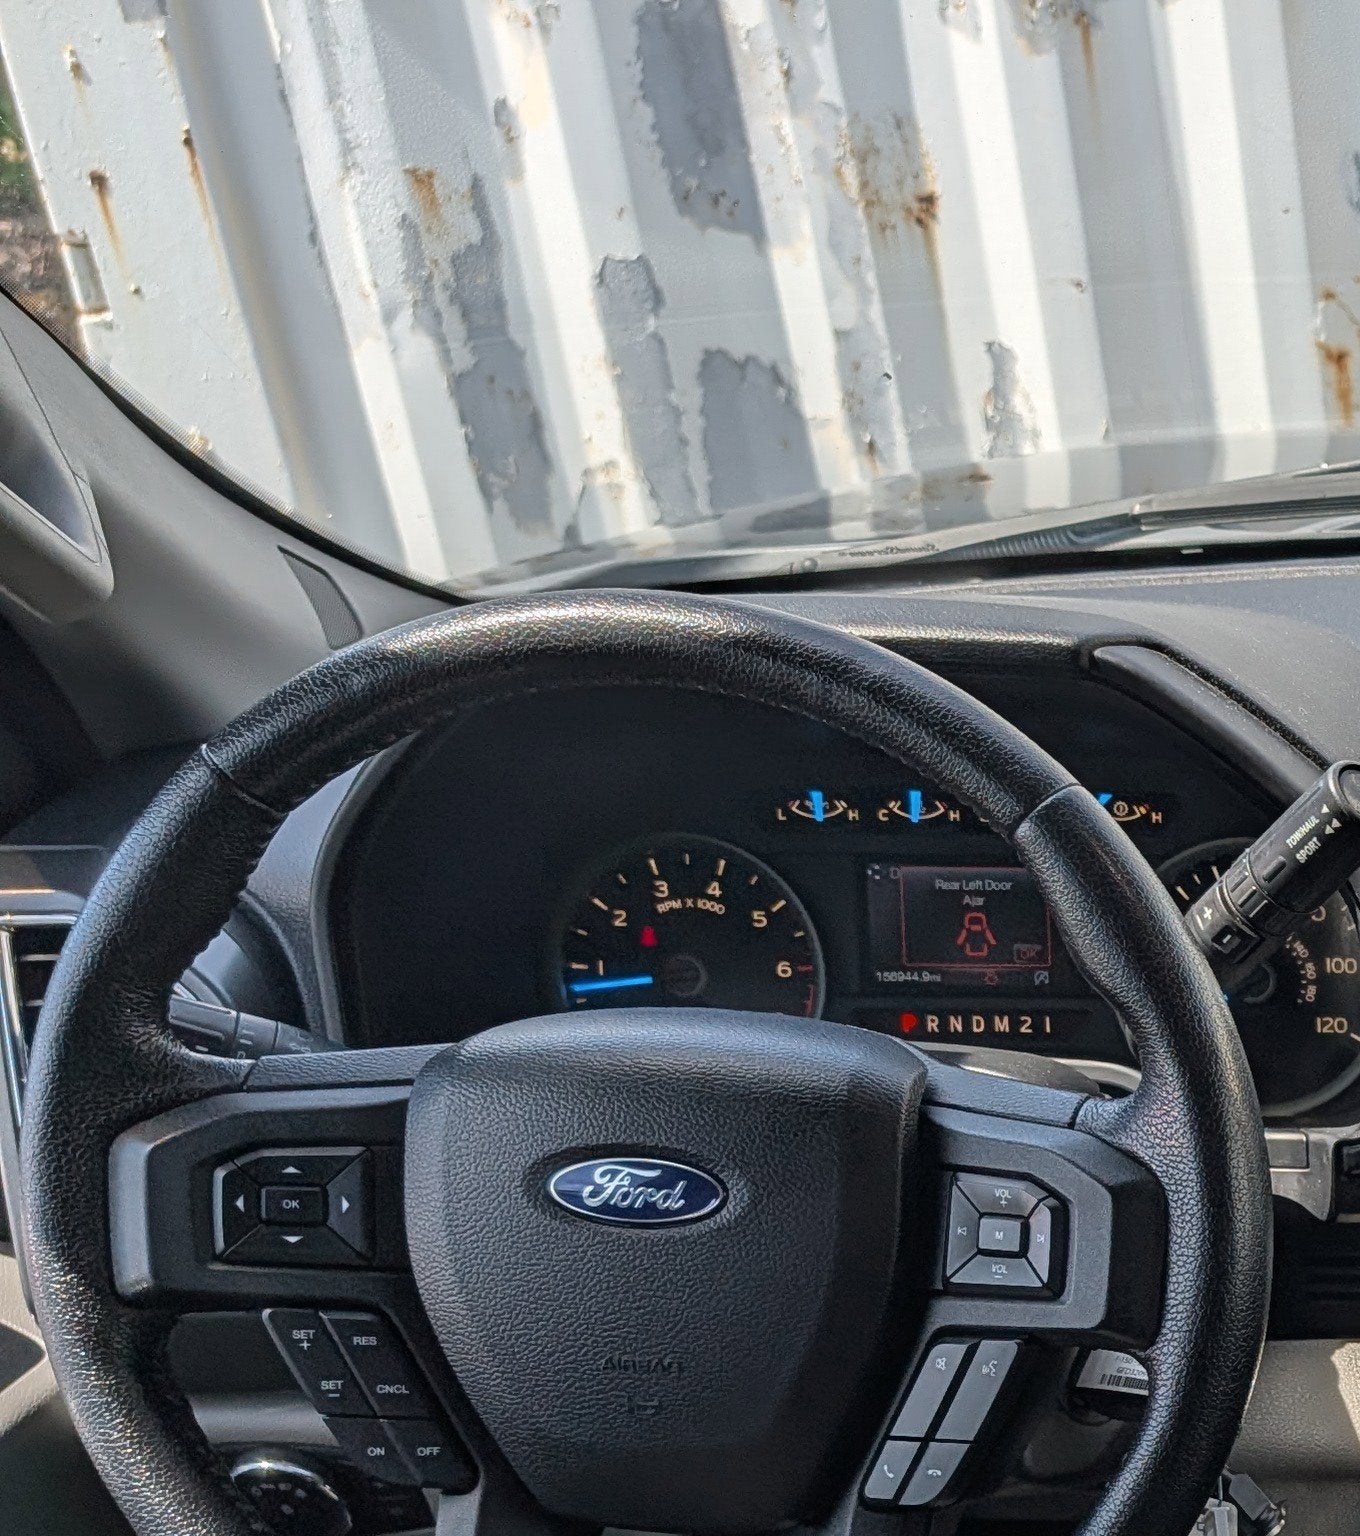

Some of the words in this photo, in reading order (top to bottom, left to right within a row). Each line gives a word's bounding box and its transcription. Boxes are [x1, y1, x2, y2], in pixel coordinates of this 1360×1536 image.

[777, 808, 787, 821] L
[848, 809, 859, 821] H
[878, 809, 890, 821] C
[949, 809, 961, 822] H
[1151, 811, 1163, 824] H
[1295, 836, 1322, 864] SPORT
[653, 880, 669, 898] 3
[706, 881, 723, 898] 4
[934, 878, 961, 891] Rear
[962, 878, 983, 891] Left
[984, 878, 1014, 891] Door
[656, 899, 683, 914] RPM
[685, 898, 695, 908] X
[697, 898, 726, 915] 1000
[612, 909, 628, 927] 2
[752, 911, 768, 928] 5
[599, 959, 605, 976] 1
[775, 960, 793, 978] 6
[1324, 956, 1359, 975] 100
[926, 1014, 940, 1034] R
[949, 1014, 963, 1034] N
[972, 1014, 986, 1034] D
[994, 1014, 1010, 1034] M
[1019, 1014, 1033, 1034] 2
[1315, 1016, 1349, 1034] 120
[582, 1164, 686, 1211] Ford
[995, 1188, 1012, 1198] VOL
[282, 1200, 300, 1209] OK
[995, 1230, 1004, 1241] M
[991, 1264, 1008, 1274] VOL
[292, 1329, 315, 1339] SET
[353, 1336, 377, 1346] RES
[320, 1380, 344, 1390] SET
[376, 1384, 409, 1394] CNCL
[367, 1447, 385, 1457] ON
[417, 1447, 441, 1457] OFF
